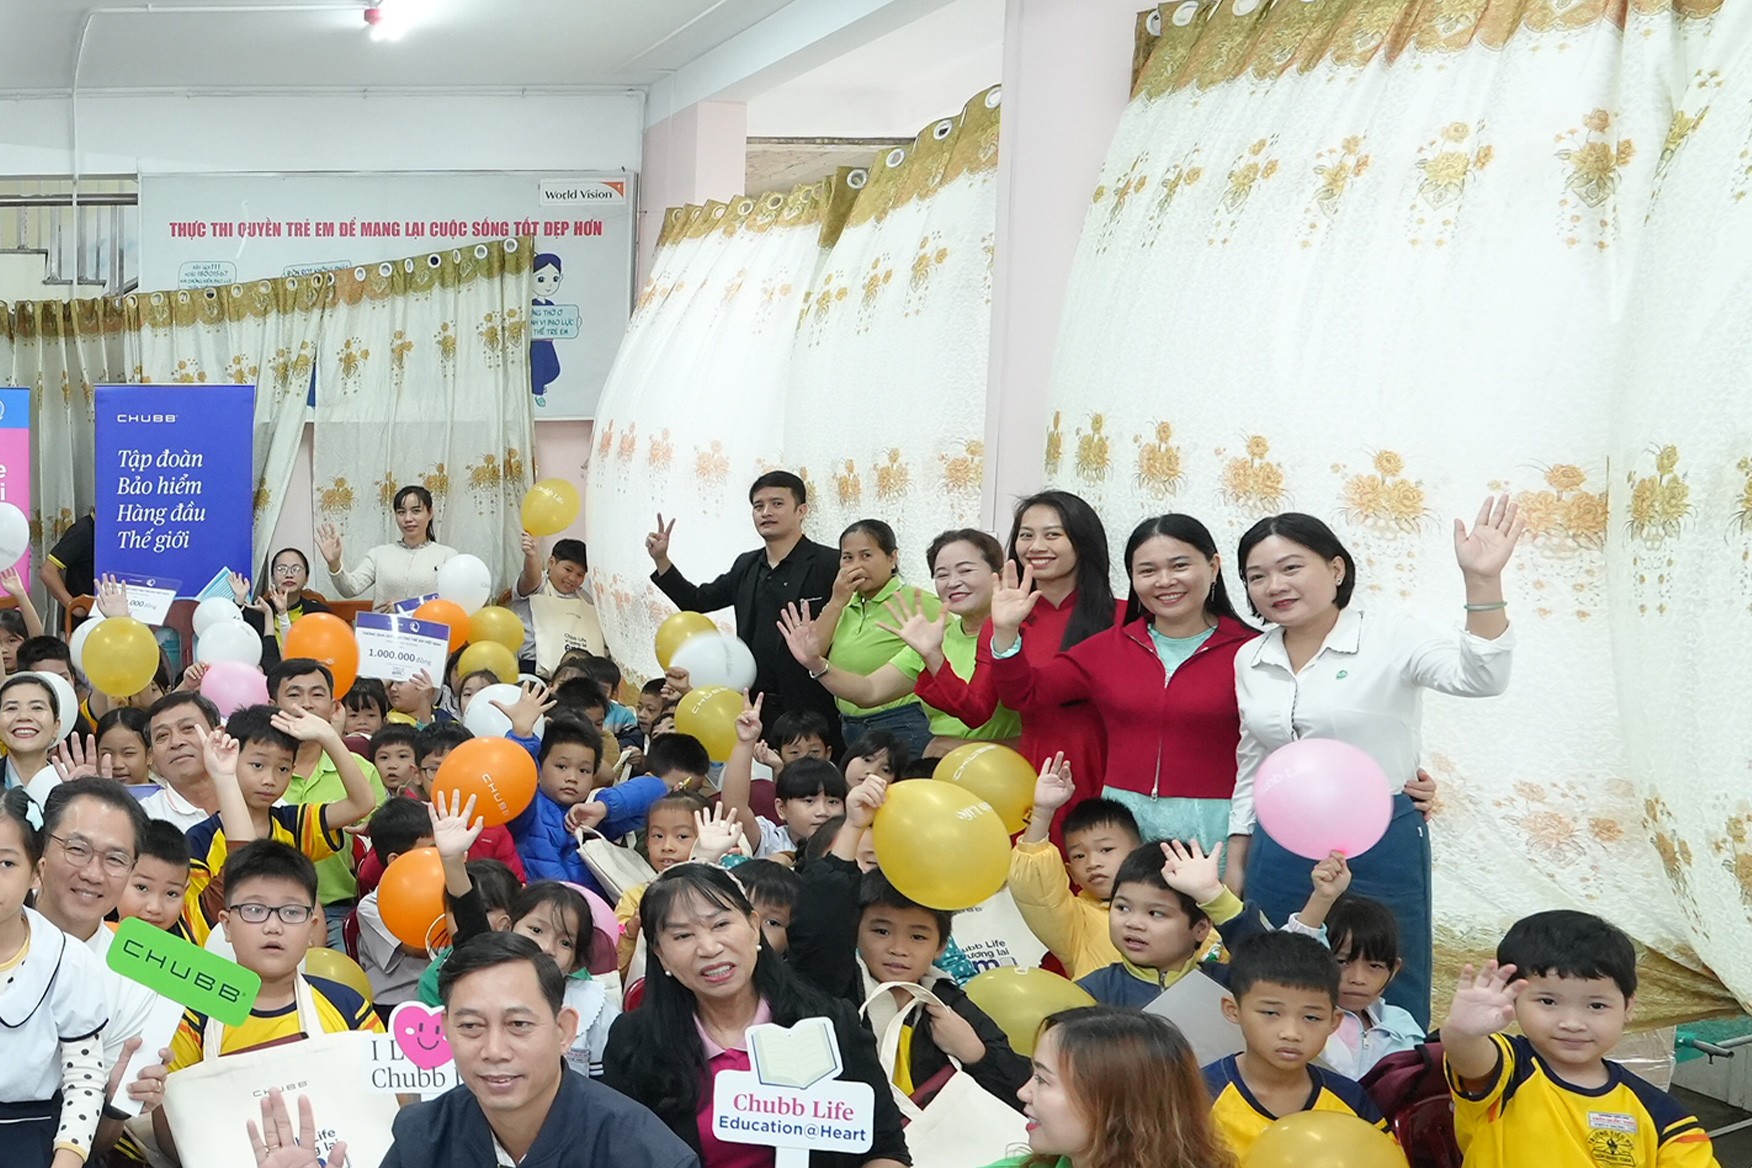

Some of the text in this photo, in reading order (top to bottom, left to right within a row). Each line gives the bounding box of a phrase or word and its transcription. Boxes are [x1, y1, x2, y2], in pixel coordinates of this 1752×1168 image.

[544, 190, 613, 200] World Vision
[170, 217, 602, 240] THỰC THI QUYỀN TRẺ EM ĐỂ MANG LẠI CUỘC SỐNG TỐT ĐẸP HƠN
[117, 414, 176, 423] CHUBB
[118, 449, 203, 471] Tập đoàn
[117, 474, 202, 495] Bảo hiểm
[117, 501, 206, 525] Hàng đầu
[118, 528, 190, 553] Thế giới
[369, 649, 415, 662] 1.000.000
[962, 940, 1006, 952] ubb Life
[967, 948, 1009, 959] ương lai
[123, 939, 241, 1003] CHUBB
[372, 1040, 378, 1061] I
[372, 1067, 446, 1089] Chubb
[733, 1093, 854, 1121] Chubb Life
[719, 1115, 866, 1141] Education@Heart
